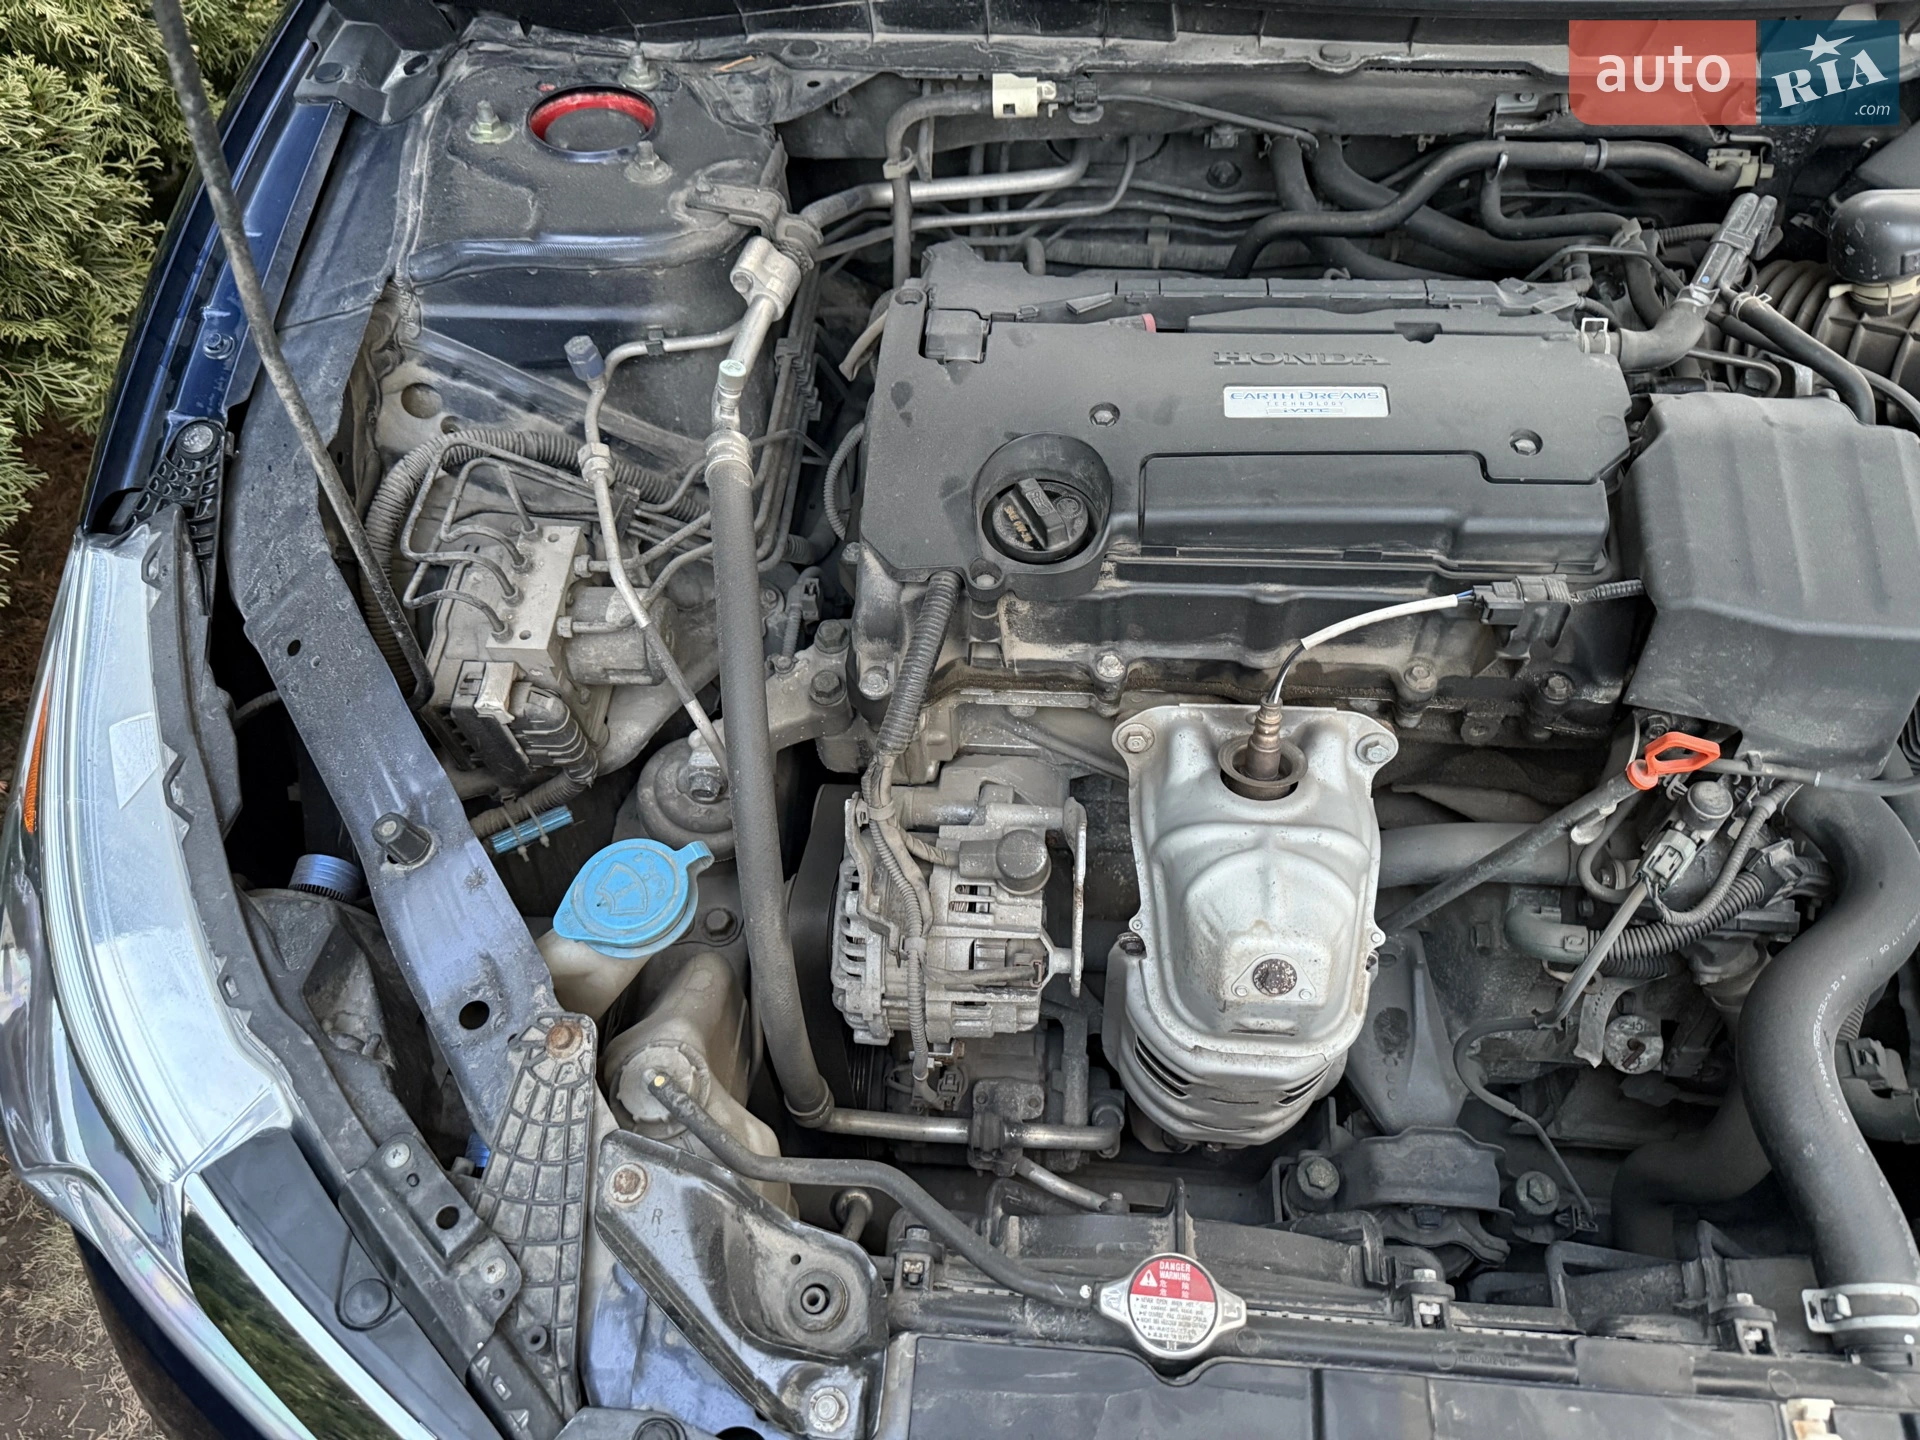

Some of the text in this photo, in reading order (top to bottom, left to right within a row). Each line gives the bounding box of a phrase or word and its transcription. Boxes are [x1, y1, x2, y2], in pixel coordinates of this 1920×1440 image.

[1213, 351, 1391, 366] HONDA
[1230, 391, 1379, 400] EARTH DREAMS
[1159, 1261, 1191, 1272] DANGER
[1159, 1270, 1191, 1282] WARNUNG
